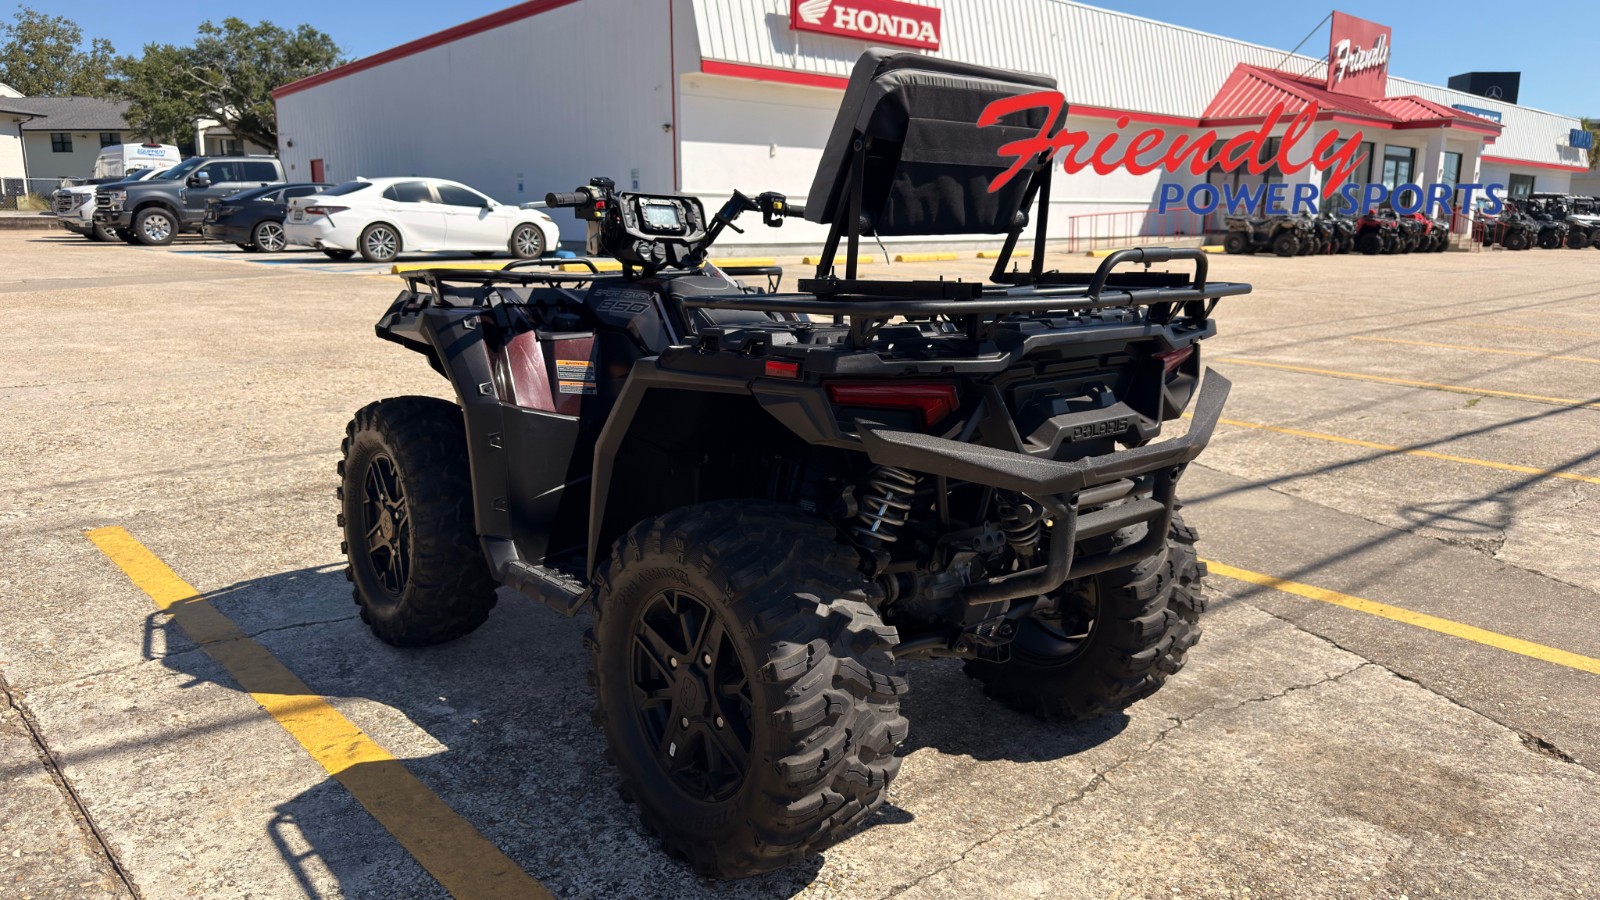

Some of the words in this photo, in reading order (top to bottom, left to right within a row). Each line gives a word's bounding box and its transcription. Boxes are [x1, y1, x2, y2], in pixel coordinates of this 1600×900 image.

[833, 6, 939, 44] HONDA
[1334, 33, 1389, 83] Friendly
[1072, 417, 1128, 441] POLARIS
